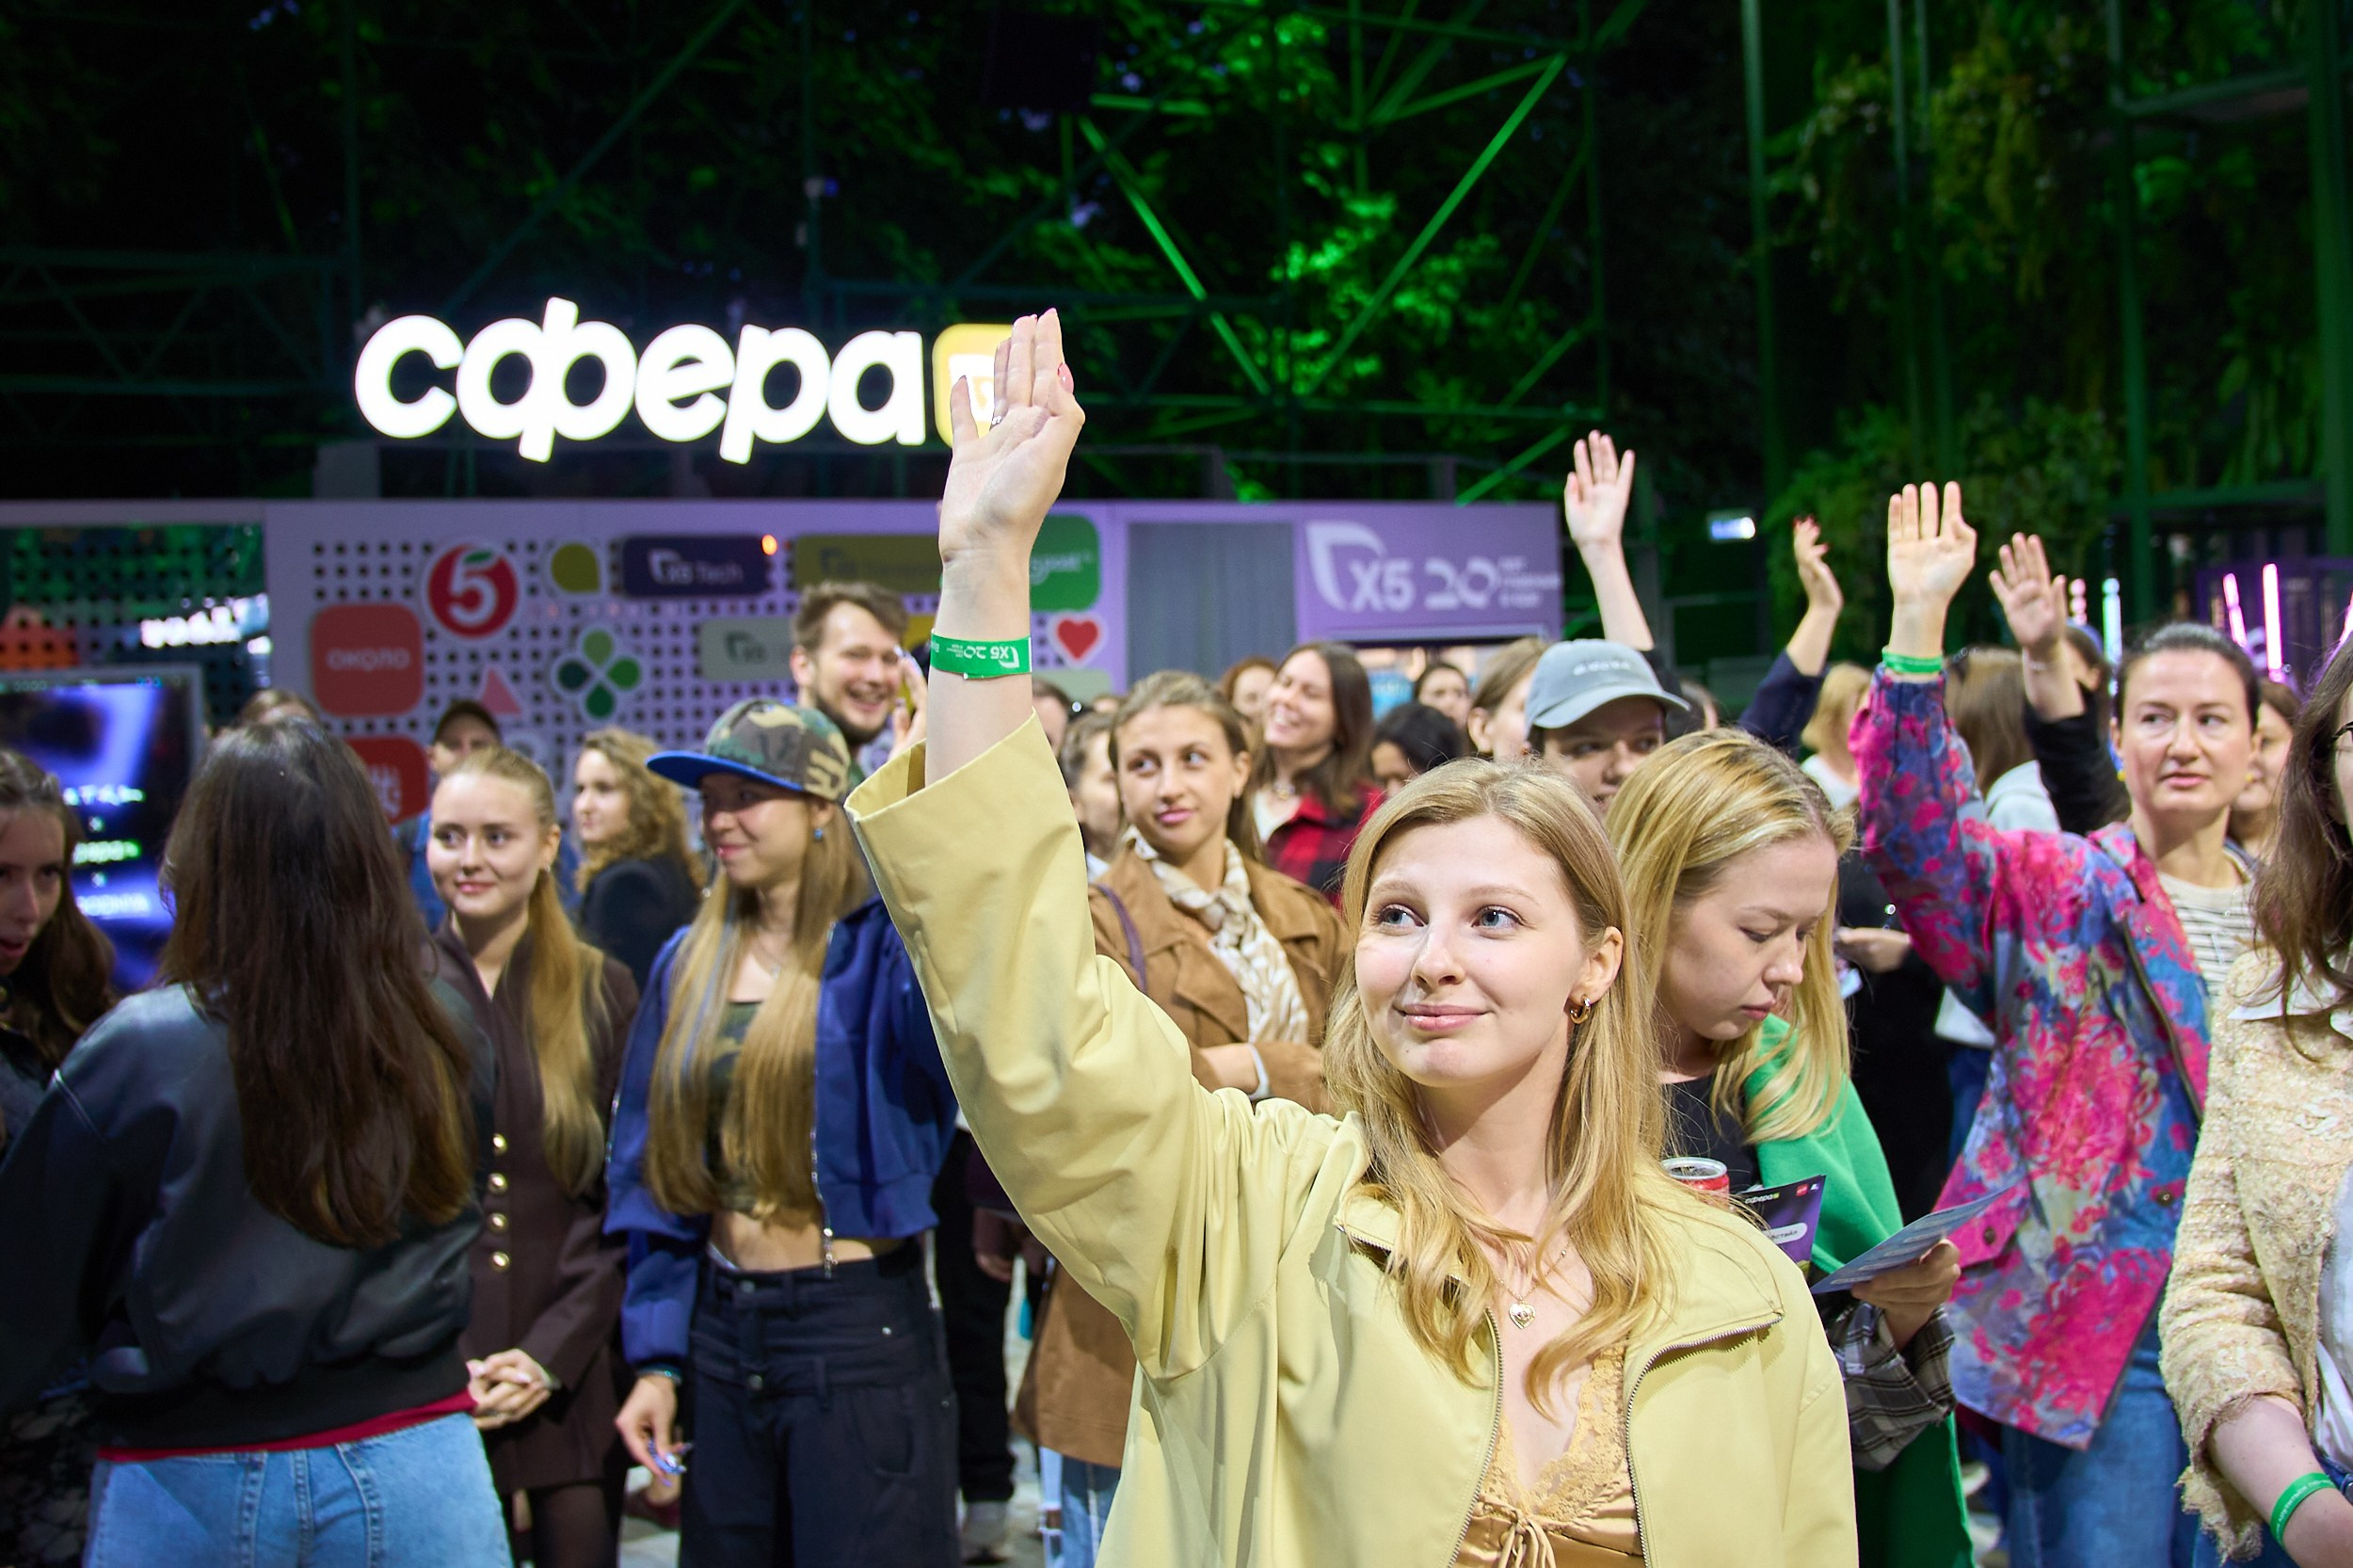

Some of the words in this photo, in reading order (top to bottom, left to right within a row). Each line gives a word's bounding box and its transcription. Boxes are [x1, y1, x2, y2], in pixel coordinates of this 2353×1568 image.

[355, 296, 926, 464] сфера
[448, 547, 499, 625] 5
[1347, 558, 1417, 612] X5
[1423, 556, 1499, 609] 20
[963, 645, 986, 660] 20
[990, 646, 1010, 660] X5
